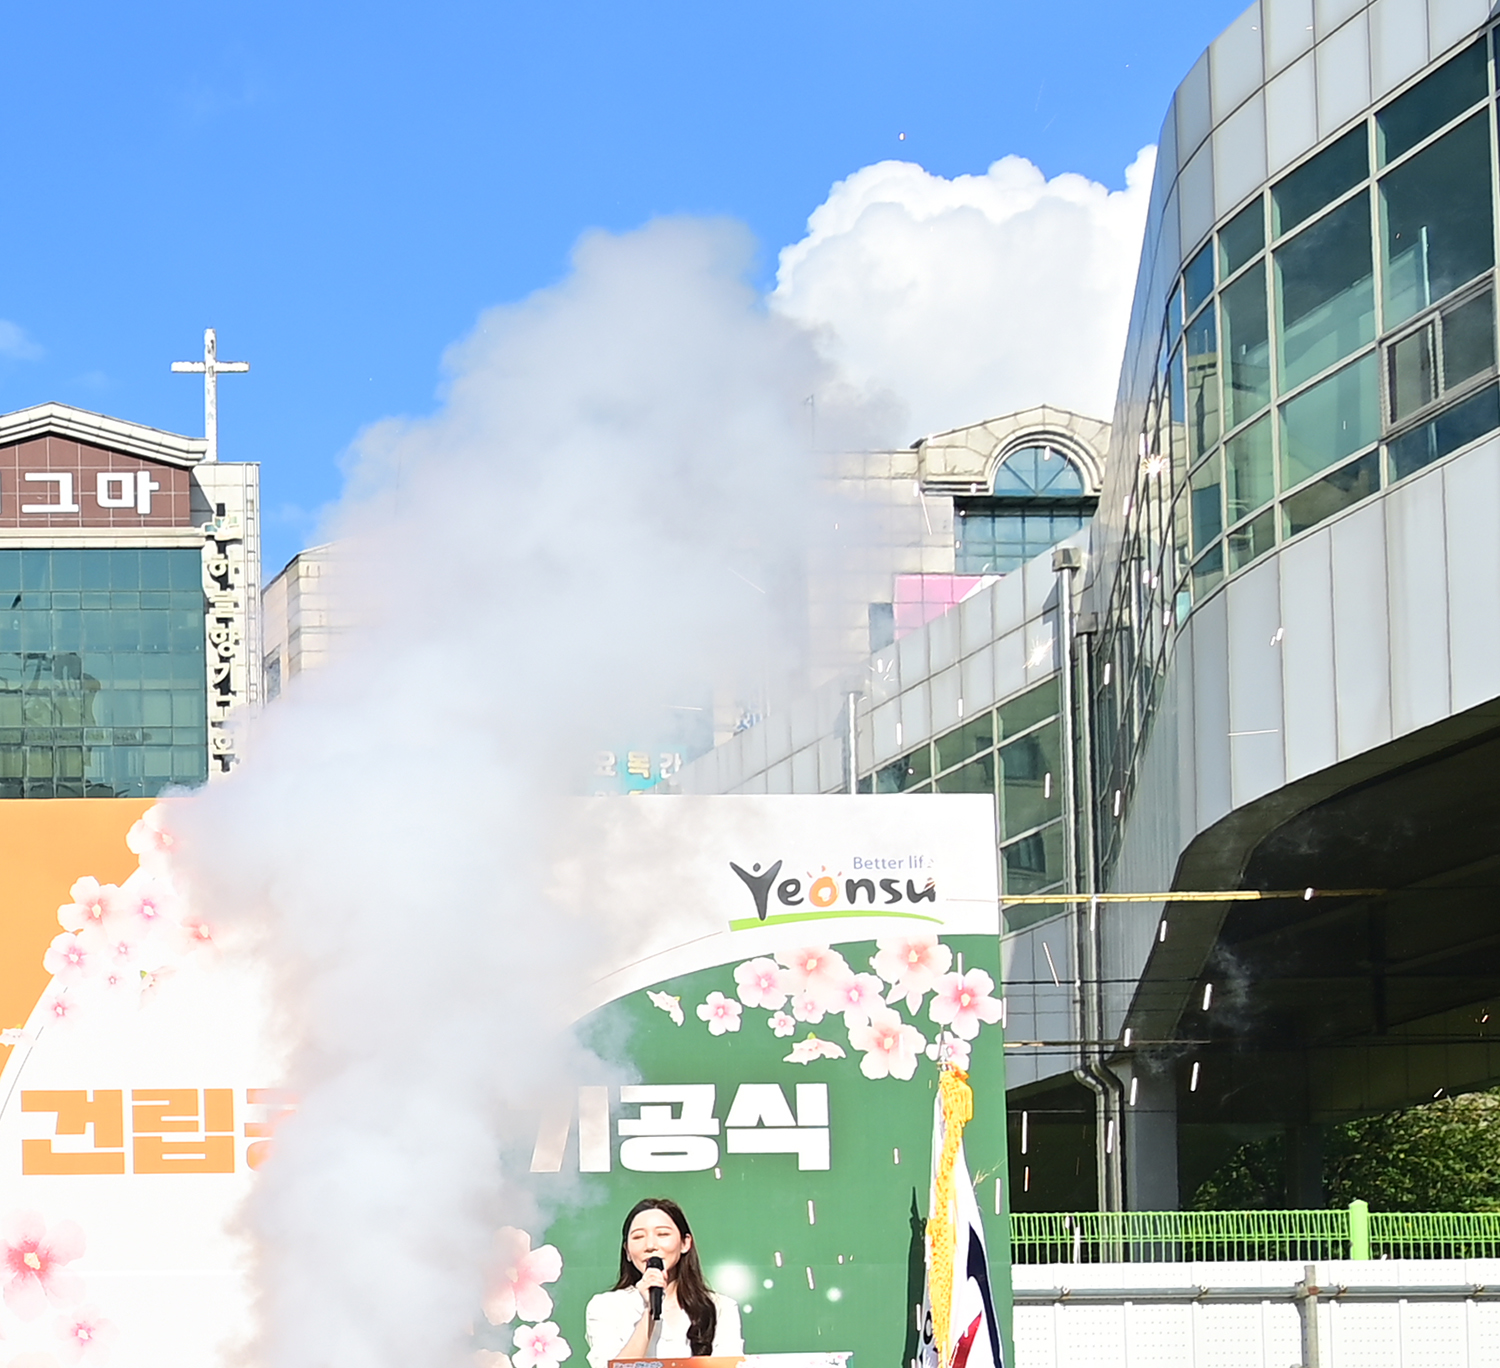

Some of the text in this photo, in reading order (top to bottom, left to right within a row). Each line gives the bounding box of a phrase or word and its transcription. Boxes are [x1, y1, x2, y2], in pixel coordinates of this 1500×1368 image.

[729, 859, 937, 921] Yeonsu
[853, 854, 934, 870] Better lif
[21, 1087, 300, 1176] 건립
[508, 1083, 830, 1174] 기공식
